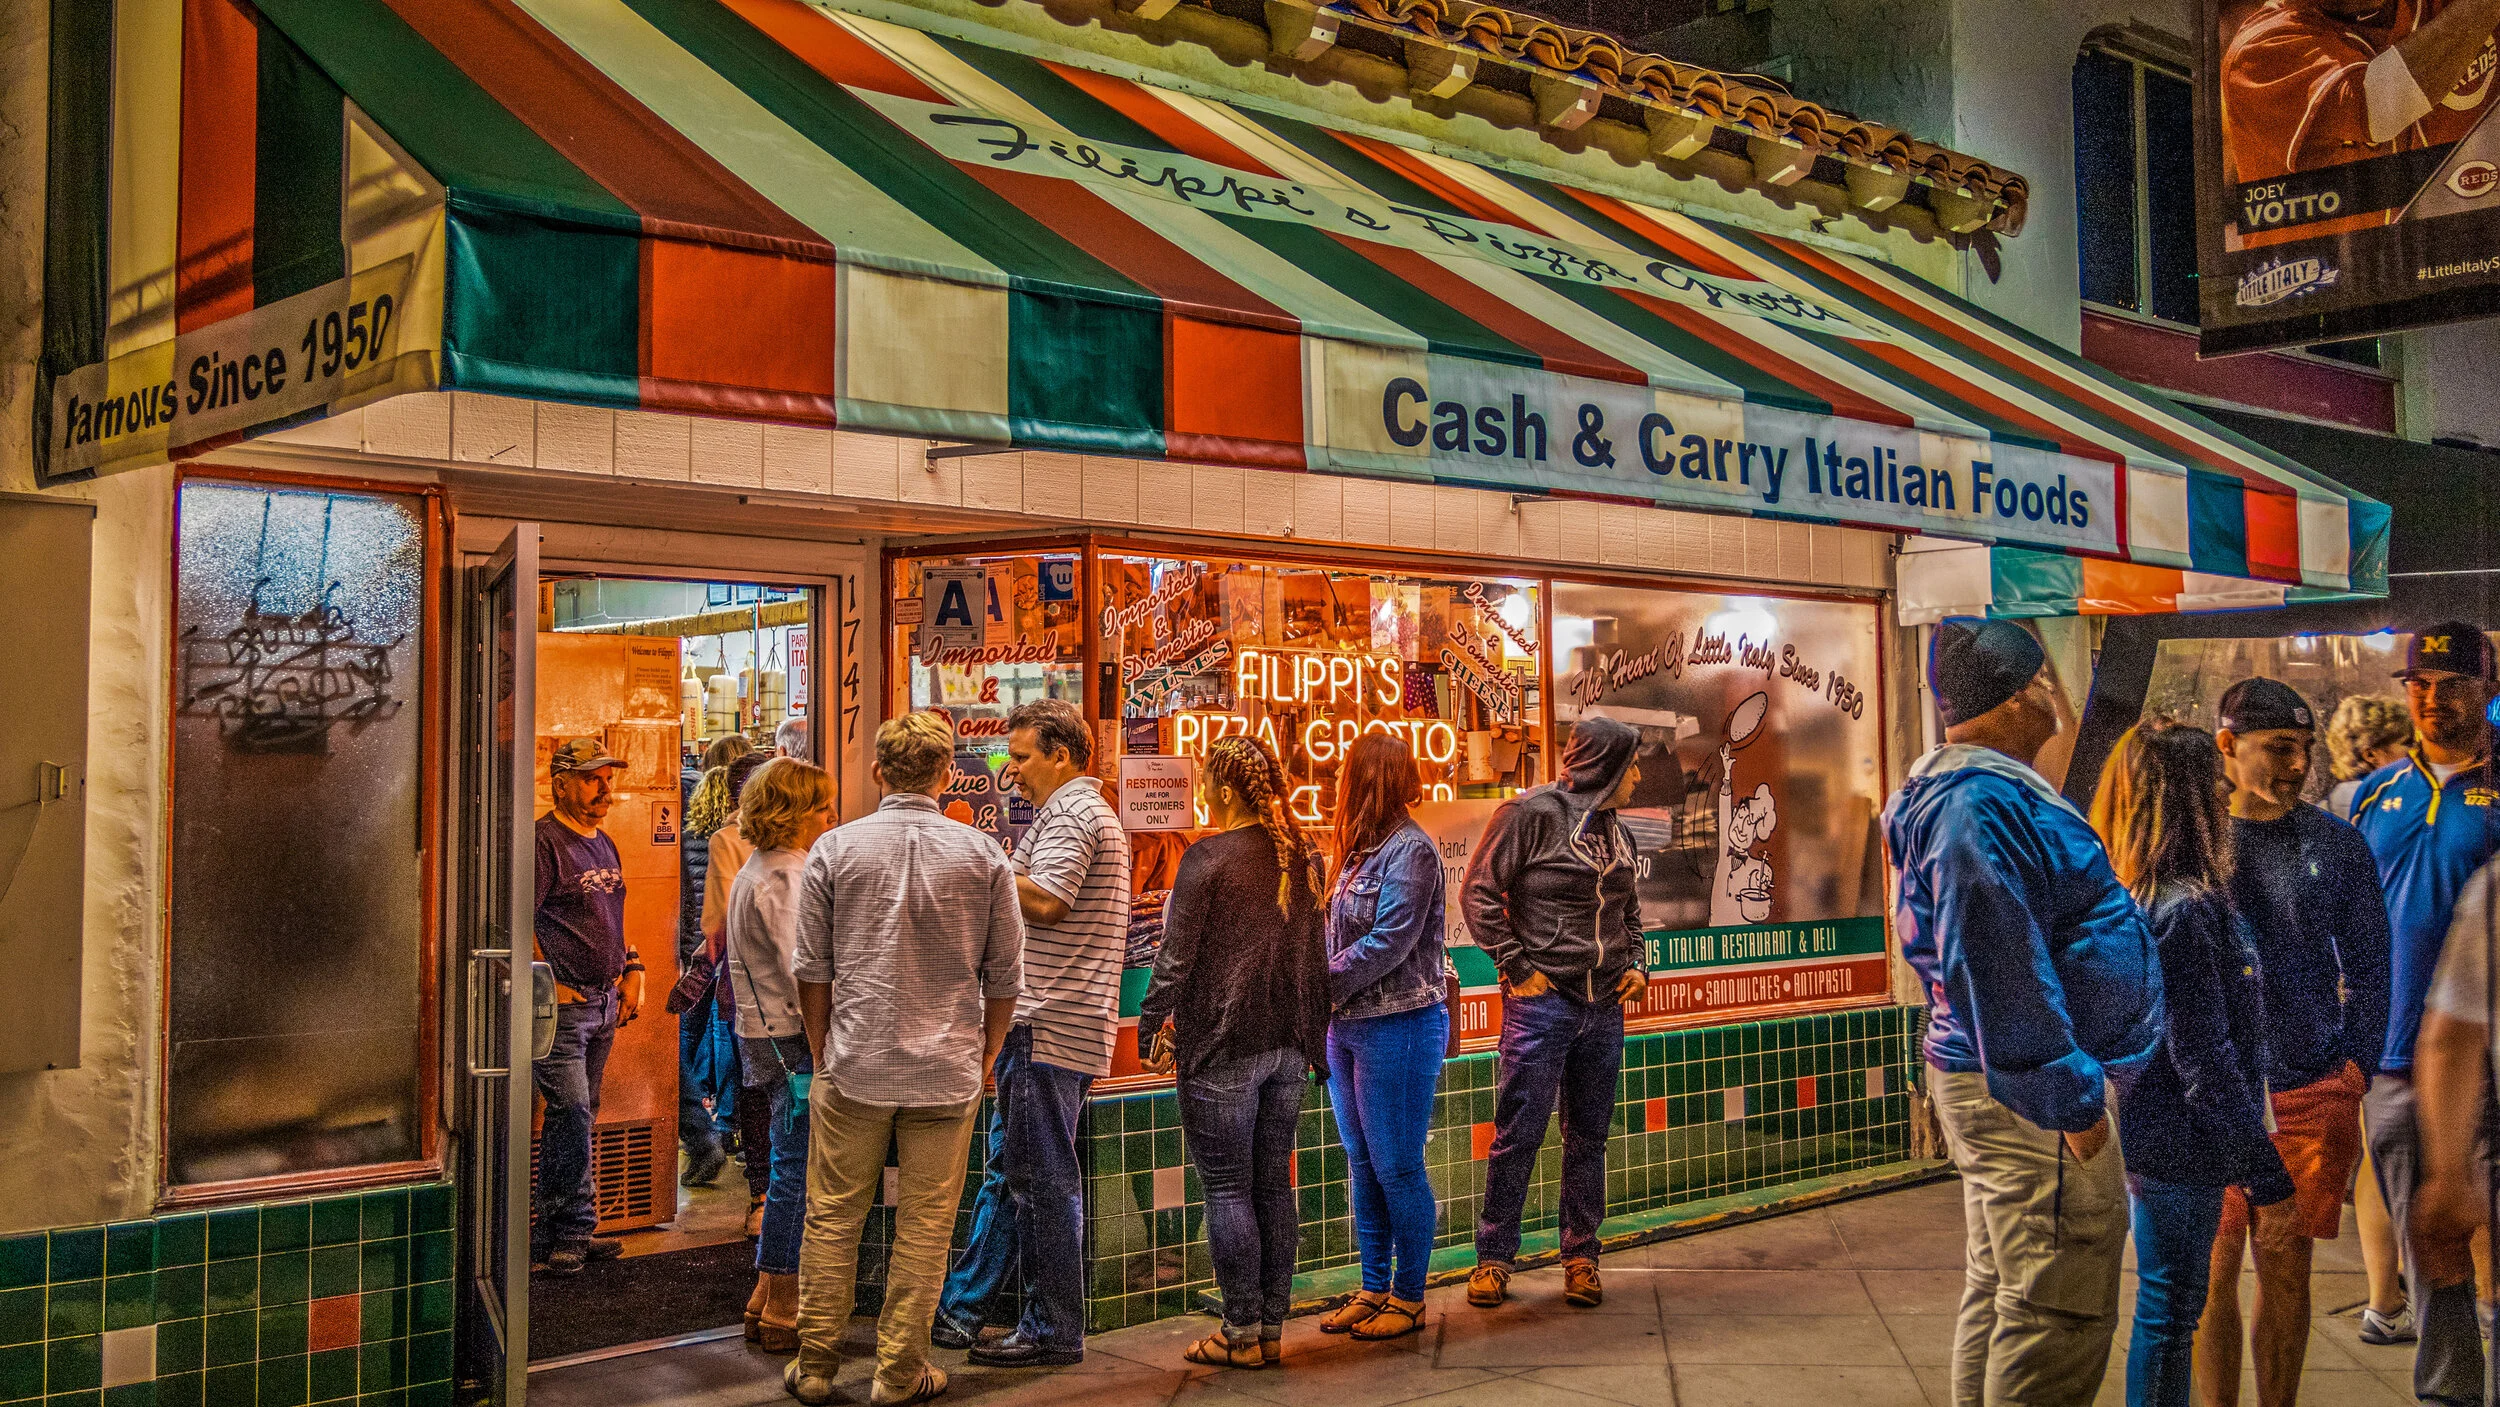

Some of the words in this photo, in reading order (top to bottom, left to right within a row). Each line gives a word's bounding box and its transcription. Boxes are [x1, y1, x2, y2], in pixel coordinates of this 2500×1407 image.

[2244, 183, 2288, 204] JOEY
[2460, 170, 2499, 187] REDS
[929, 112, 1390, 231] Filippi's
[1388, 205, 1638, 282] Pizza
[1645, 261, 1850, 322] Grotto
[2244, 191, 2341, 226] VOTTO
[2240, 276, 2268, 303] LITTLE
[2271, 262, 2309, 292] ITALY
[2416, 256, 2500, 281] #LittleItalyS
[63, 379, 179, 449] Famous
[187, 347, 288, 414] Since
[301, 293, 394, 383] 1950
[1383, 376, 1548, 462] Cash
[1572, 403, 1617, 470] &
[1638, 412, 1789, 504] Carry
[1804, 437, 1956, 511] Italian
[1971, 459, 2090, 529] Foods
[934, 580, 973, 626] A
[1104, 561, 1197, 638] Imported
[1463, 581, 1540, 657] Imported
[1154, 614, 1172, 641] &
[1485, 633, 1502, 656] &
[2421, 635, 2451, 654] M
[843, 574, 861, 745] 1747
[920, 629, 1059, 678] Imported
[1122, 618, 1215, 685] Domestic
[1449, 621, 1520, 698] Domestic
[978, 675, 1001, 704] &
[1126, 638, 1230, 710] WINES
[1238, 650, 1402, 706] FILIPPI'S
[1439, 648, 1512, 719] CHEESE
[1570, 665, 1604, 715] The
[1607, 643, 1659, 693] Heart
[1663, 629, 1684, 680] Of
[1687, 626, 1733, 667] Little
[1738, 631, 1776, 681] Italy
[1779, 642, 1820, 692] Since
[1825, 670, 1864, 721] 1950
[1176, 713, 1281, 759] PIZZA
[1125, 778, 1189, 789] RESTROOMS
[1145, 791, 1157, 799] ARE
[1158, 791, 1170, 799] FOR
[976, 804, 999, 832] &
[1129, 801, 1185, 812] CUSTOMERS
[1146, 815, 1170, 824] ONLY
[656, 825, 672, 833] BBB
[1438, 836, 1468, 859] hand
[1668, 934, 1715, 965] ITALIAN
[1721, 929, 1793, 960] RESTAURANT
[1798, 931, 1808, 953] &
[1812, 926, 1837, 953] DELI
[1647, 982, 1692, 1013] FILIPPI
[1705, 973, 1781, 1006] SANDWICHES
[1793, 966, 1853, 998] ANTIPASTO
